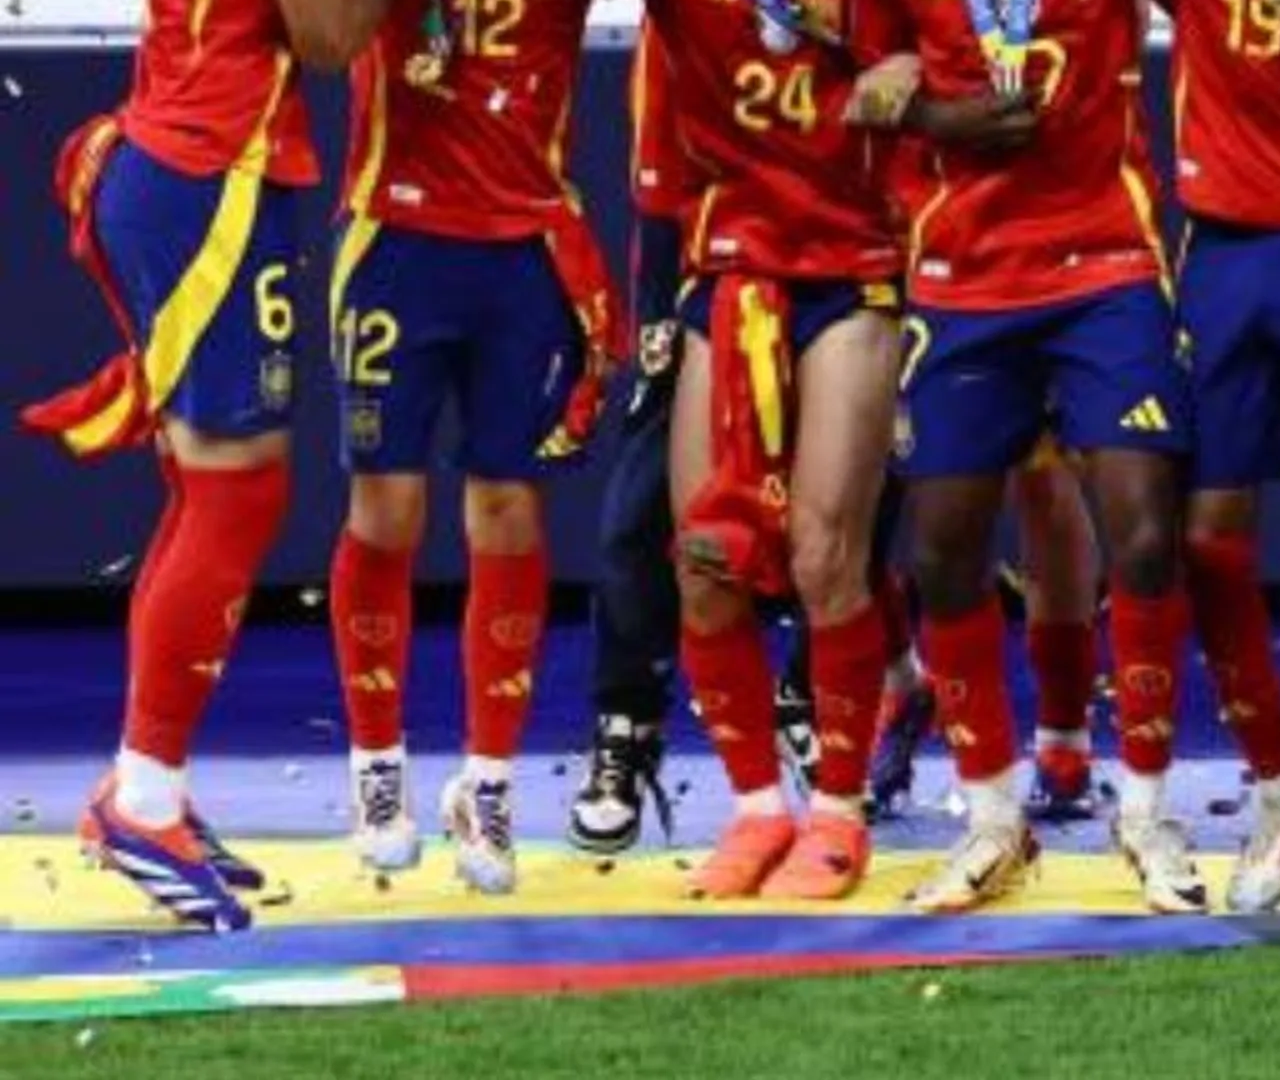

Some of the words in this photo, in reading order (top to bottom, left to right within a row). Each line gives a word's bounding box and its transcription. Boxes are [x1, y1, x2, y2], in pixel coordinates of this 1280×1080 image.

[734, 61, 818, 133] 24
[1025, 39, 1066, 107] 7
[255, 265, 294, 341] 6
[338, 309, 399, 384] 12
[899, 316, 931, 390] 7
